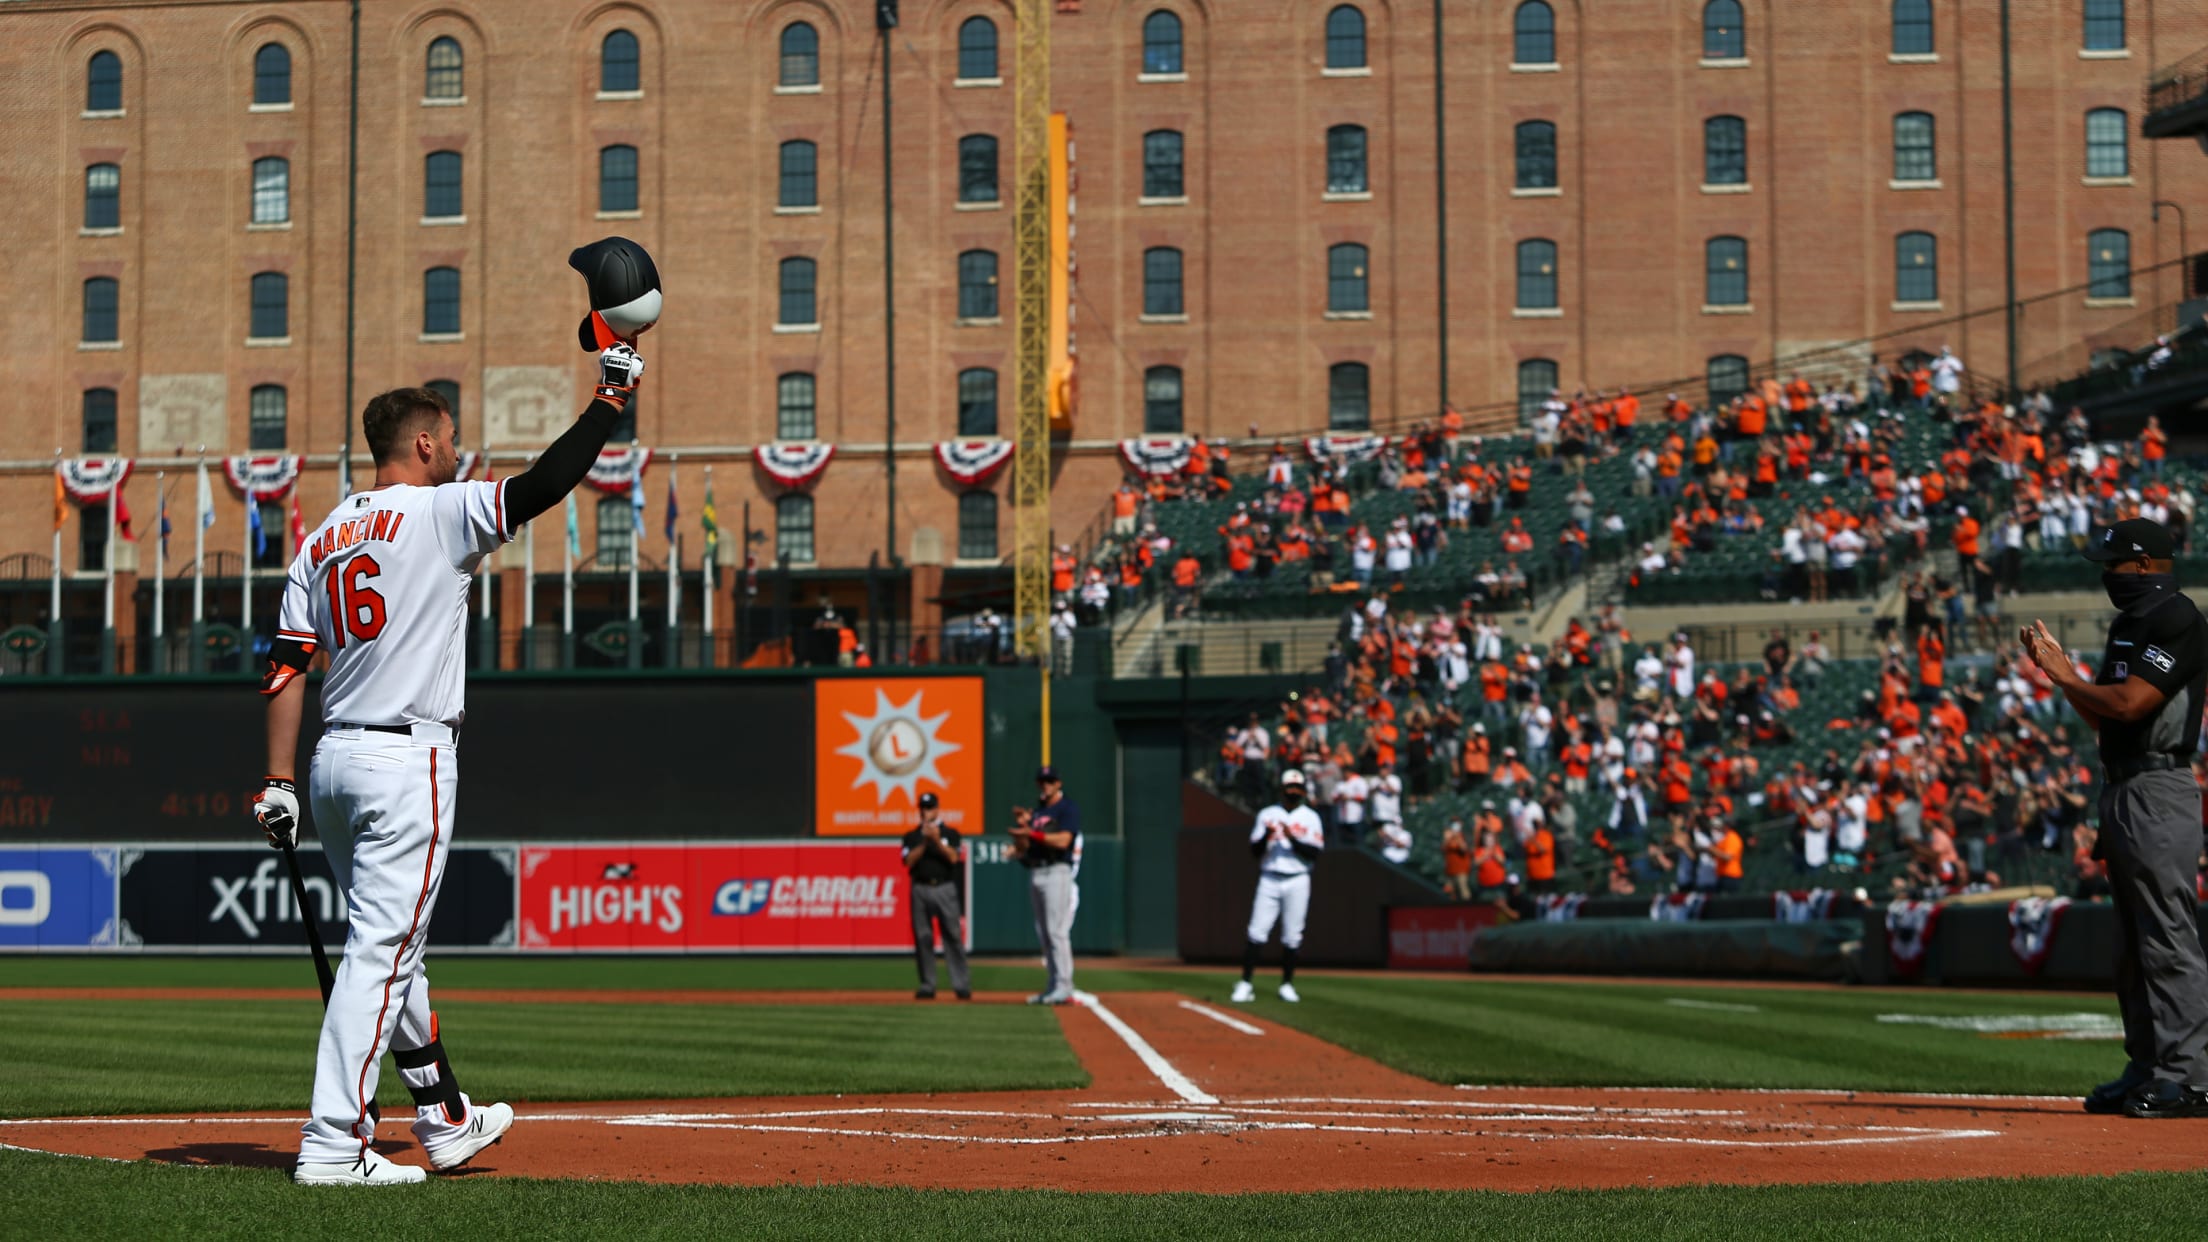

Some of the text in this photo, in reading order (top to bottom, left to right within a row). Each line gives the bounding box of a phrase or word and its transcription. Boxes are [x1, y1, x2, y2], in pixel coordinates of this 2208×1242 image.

[310, 509, 405, 570] MANCINI
[326, 553, 387, 650] 16
[891, 733, 909, 759] L
[550, 884, 683, 933] HIGH'S
[774, 876, 898, 904] CARROLL
